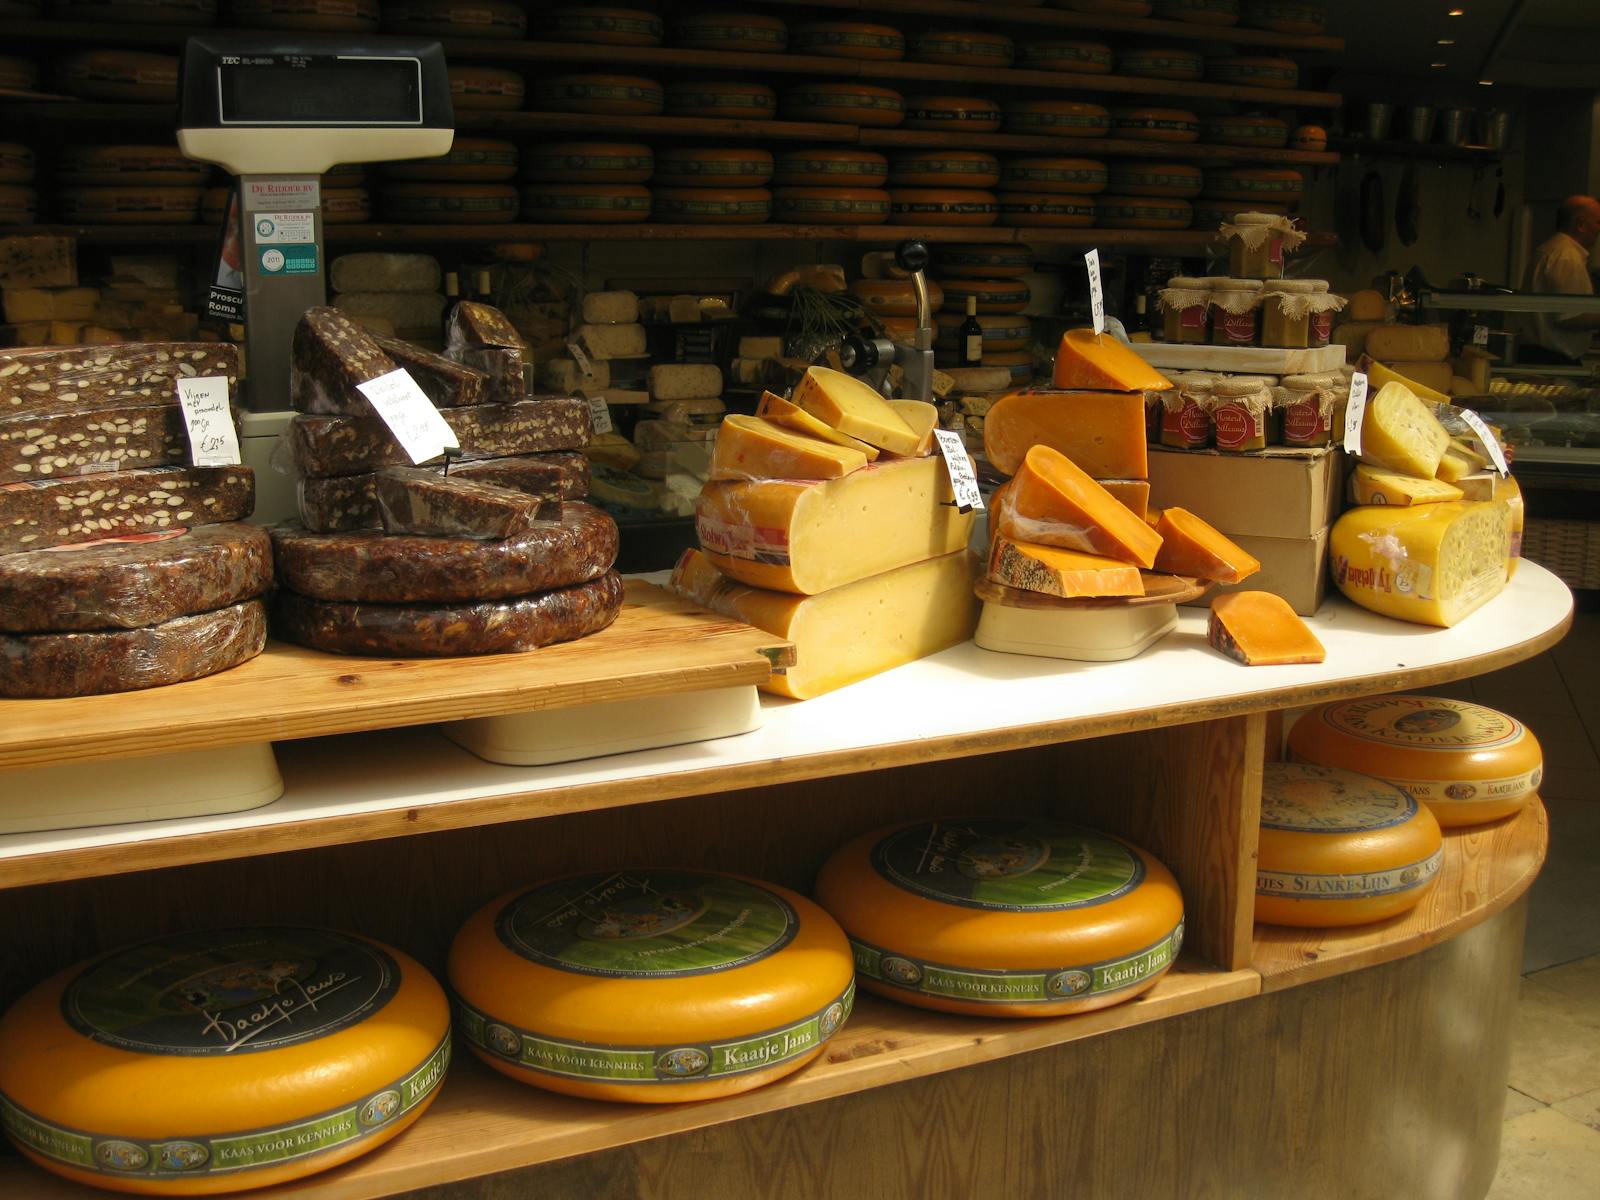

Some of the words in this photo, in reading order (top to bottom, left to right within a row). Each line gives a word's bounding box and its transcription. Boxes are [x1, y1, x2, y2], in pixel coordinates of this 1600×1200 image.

[222, 56, 240, 65] TEC
[208, 301, 237, 314] Roma
[1103, 961, 1145, 985] Kaatje
[1145, 951, 1167, 974] Jans
[929, 975, 955, 988] KAAS
[957, 980, 987, 992] VOOR
[989, 983, 1040, 993] KENNERS
[527, 1046, 553, 1061] KAAS
[554, 1053, 587, 1066] VOOR
[589, 1057, 645, 1071] KENNERS
[724, 1041, 779, 1066] Kaatje
[781, 1032, 811, 1056] Jans
[220, 1146, 254, 1160] KAAS
[256, 1138, 295, 1154] VOOR
[297, 1119, 352, 1145] KENNERS
